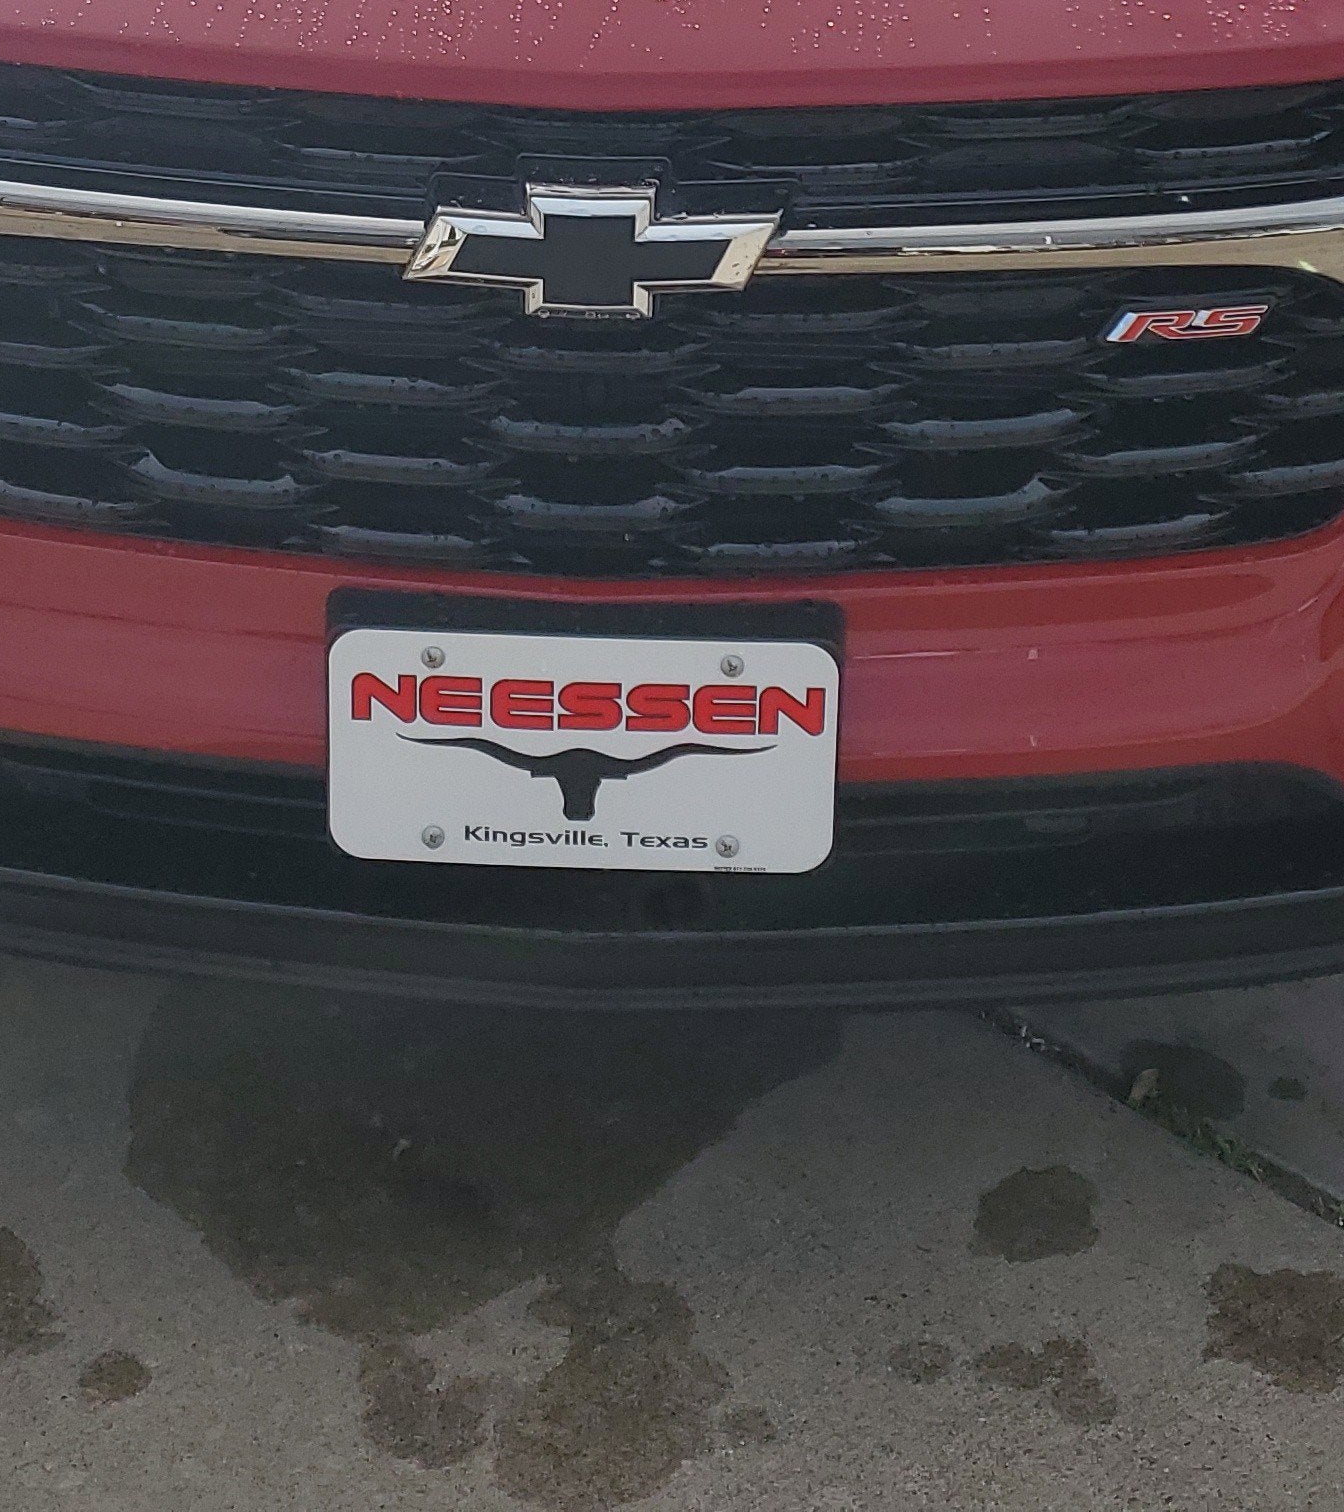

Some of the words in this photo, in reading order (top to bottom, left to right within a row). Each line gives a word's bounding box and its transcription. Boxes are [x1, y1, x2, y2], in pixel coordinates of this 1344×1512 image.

[1106, 305, 1269, 343] RS
[350, 671, 826, 737] NEESSEN
[621, 830, 709, 850] Texas
